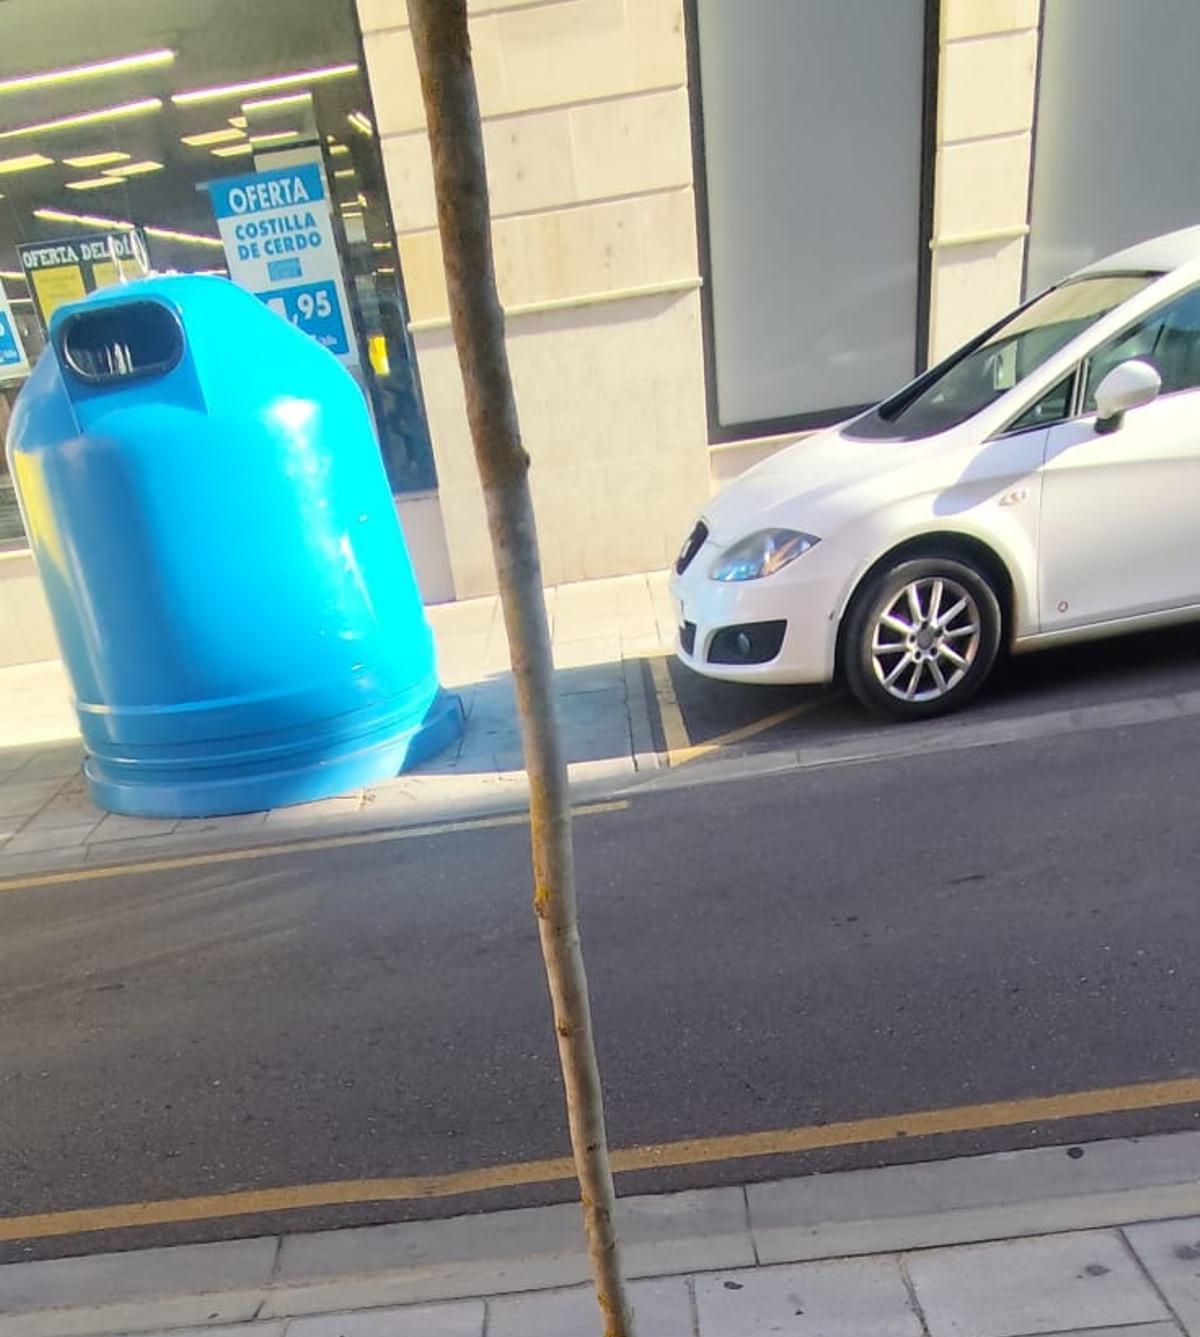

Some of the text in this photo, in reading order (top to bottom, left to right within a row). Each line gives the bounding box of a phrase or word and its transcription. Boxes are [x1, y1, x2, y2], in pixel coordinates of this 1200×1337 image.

[228, 176, 309, 213] OFERTA
[235, 212, 316, 240] COSTILLA
[22, 245, 79, 268] OFERTA
[80, 241, 111, 260] DEL
[237, 231, 322, 260] DE CERDO
